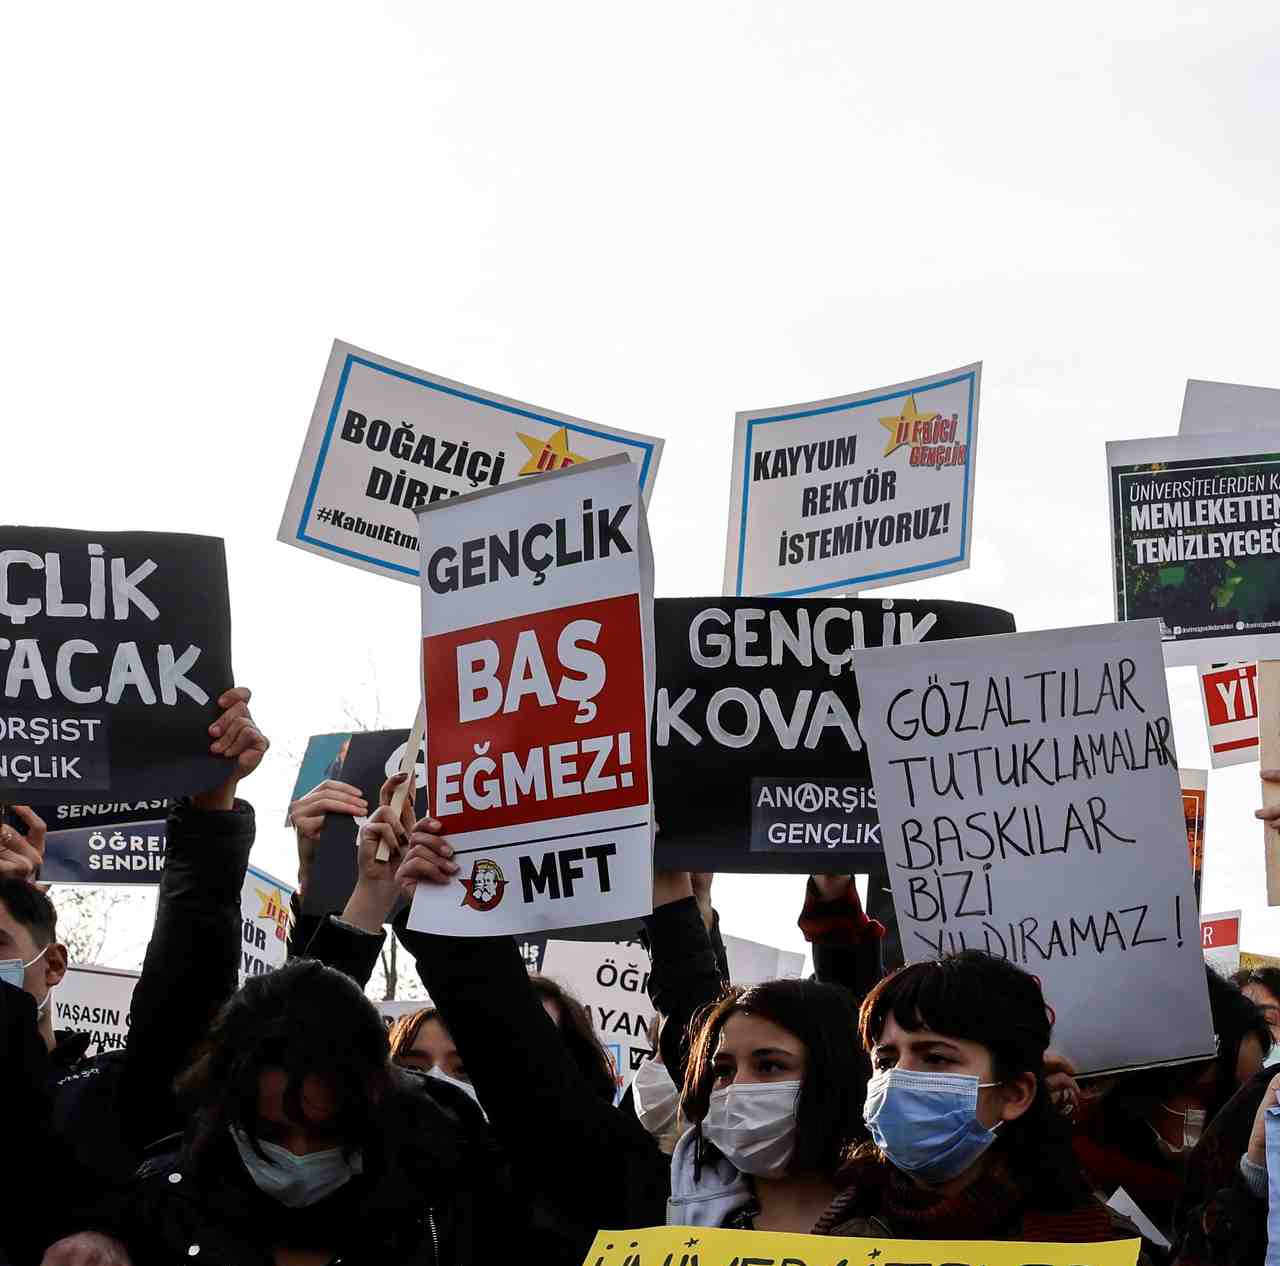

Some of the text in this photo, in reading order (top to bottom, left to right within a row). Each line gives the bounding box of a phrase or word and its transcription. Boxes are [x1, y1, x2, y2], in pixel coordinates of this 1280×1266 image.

[341, 409, 505, 487] BOĞAZİÇİ
[753, 435, 857, 482] KAYYUM
[365, 466, 462, 510] DİRE
[802, 468, 897, 517] REKTÖR
[1129, 474, 1265, 502] ÜNİVERSİTELERDEN
[428, 499, 632, 594] GENÇLİK
[779, 502, 950, 566] İSTEMİYORUZ!
[456, 619, 606, 724] BAŞ
[886, 657, 1145, 742] GÖZALTILAR
[656, 686, 864, 751] KOVA
[436, 732, 634, 817] EĞMEZ!
[889, 716, 1178, 807] TUTUKLAMALAR
[88, 831, 166, 854] ÖĞRE
[896, 797, 1138, 870] BASKILAR
[519, 843, 616, 903] MFT
[903, 863, 995, 923] BİZİ
[55, 1001, 120, 1027] YAŞASIN
